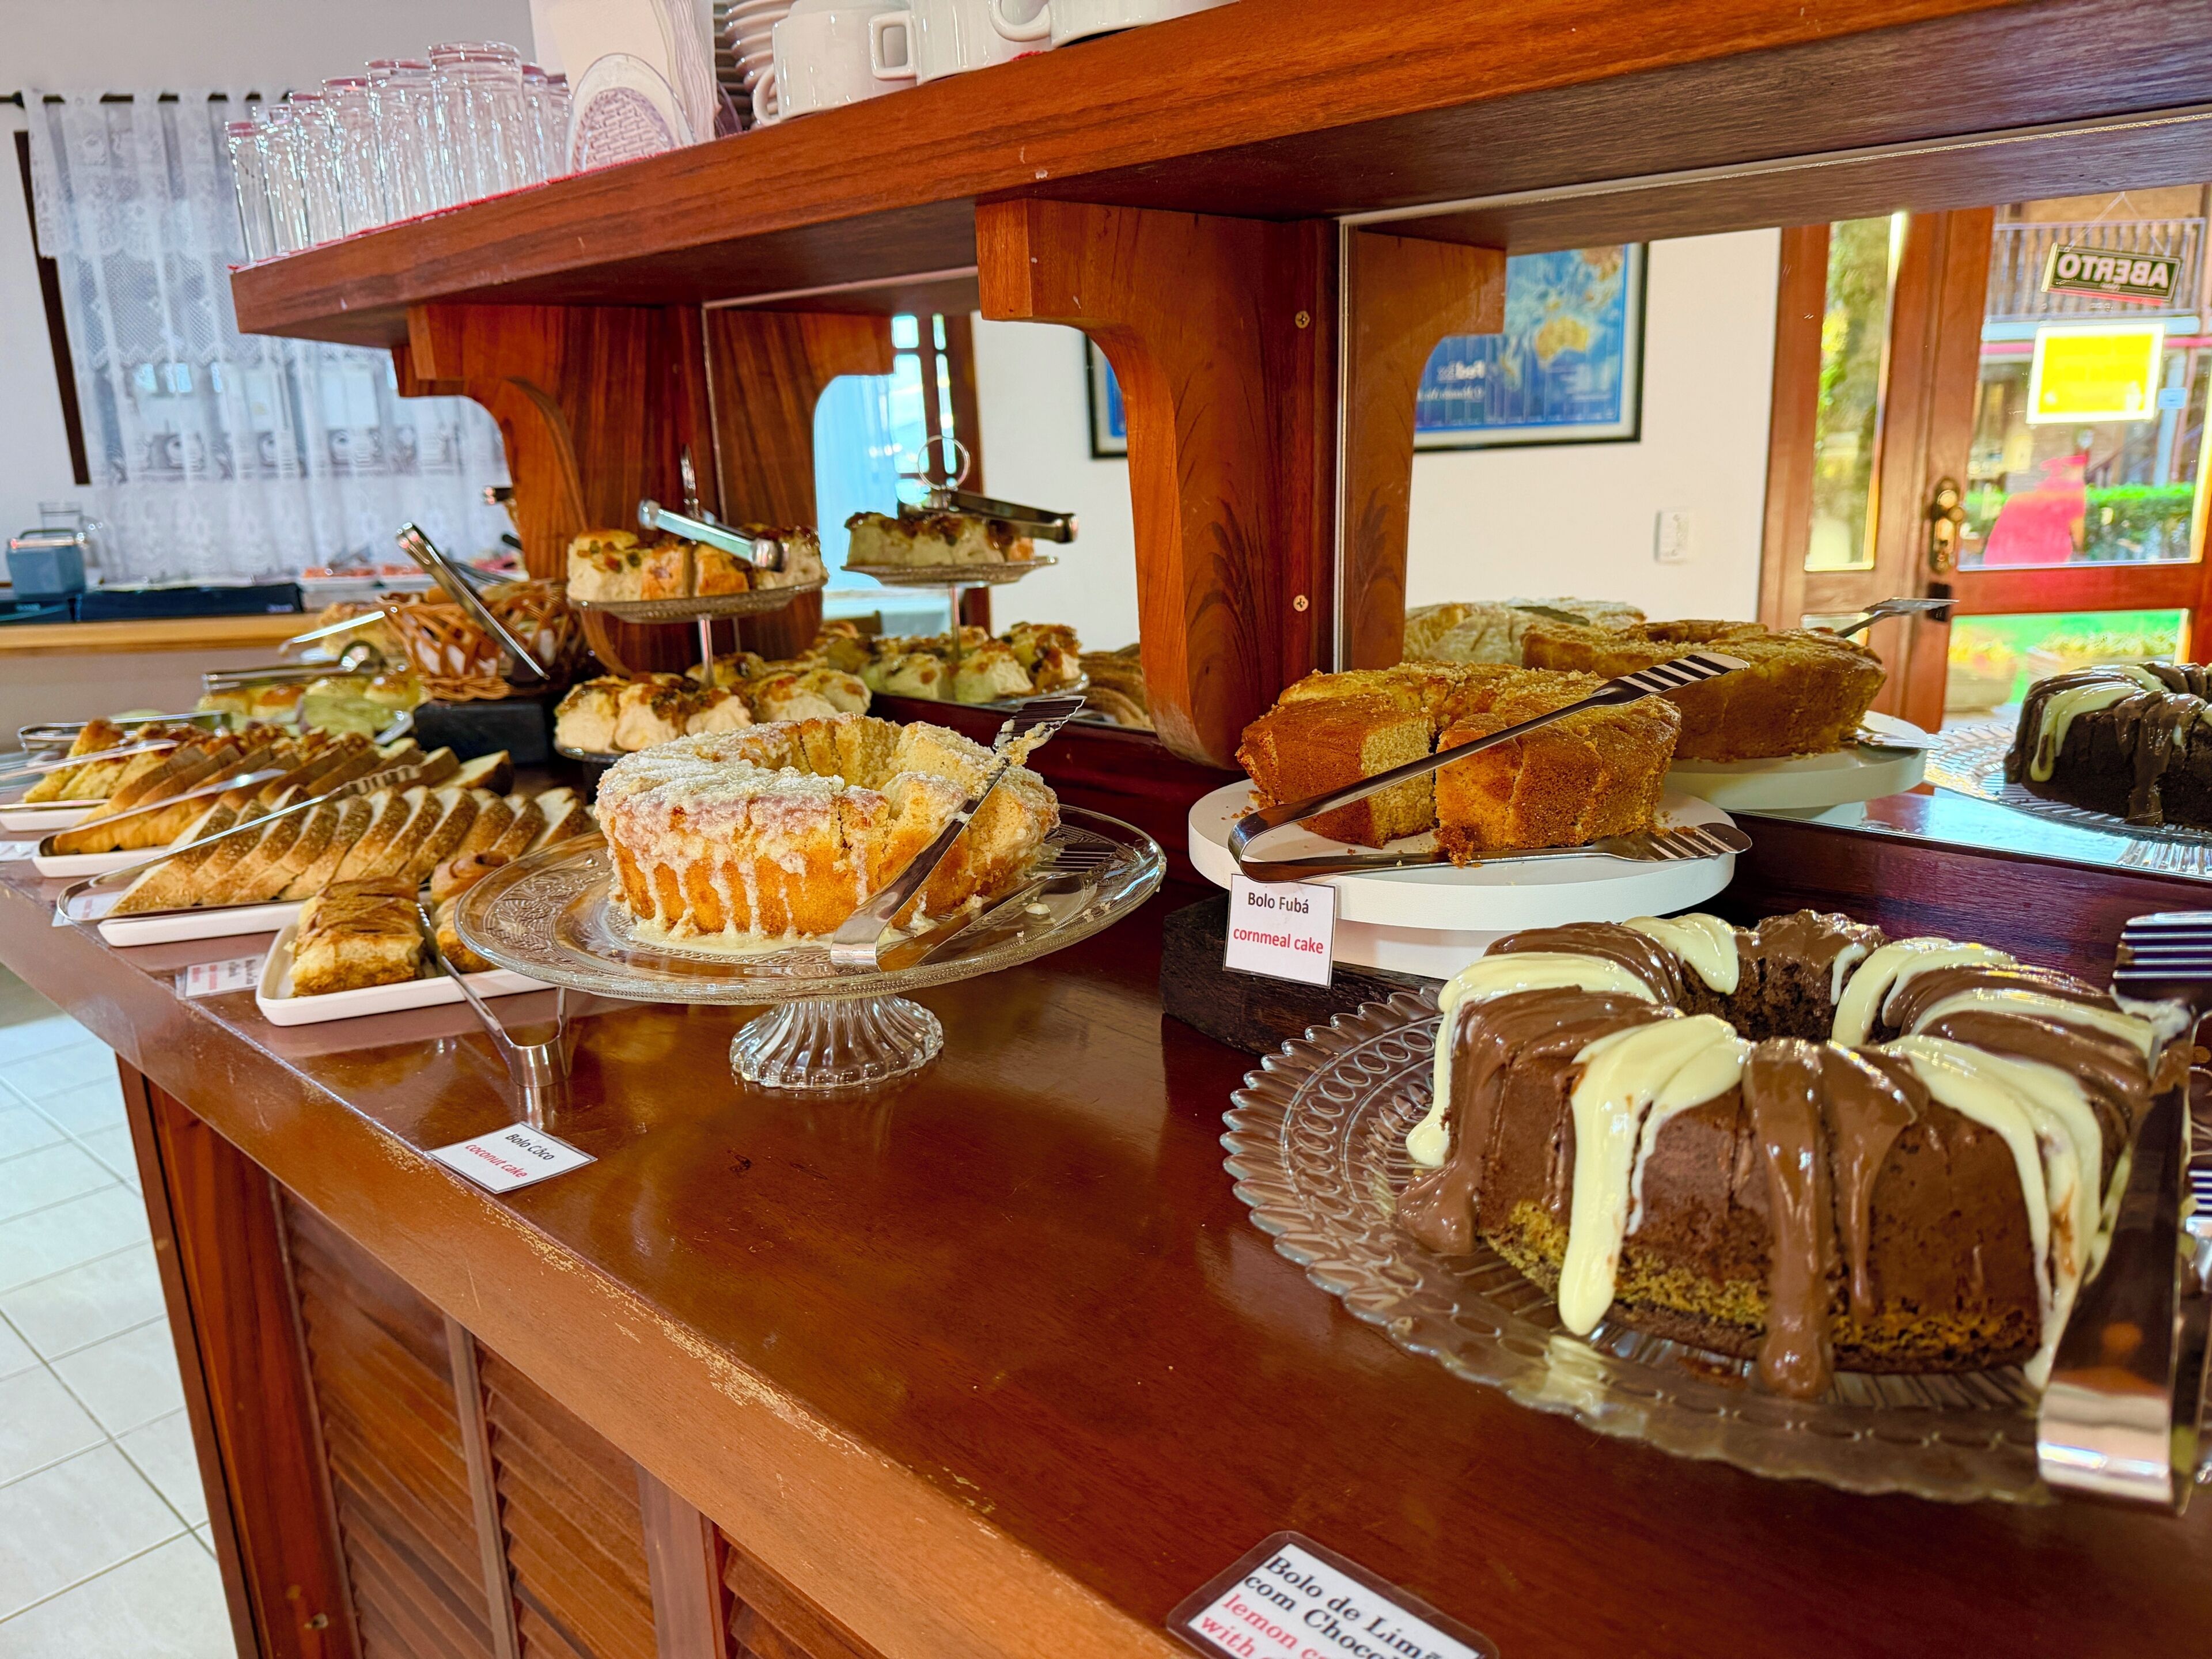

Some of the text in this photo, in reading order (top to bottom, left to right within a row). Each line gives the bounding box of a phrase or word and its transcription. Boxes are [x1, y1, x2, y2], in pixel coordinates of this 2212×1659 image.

[1248, 892, 1309, 914] Bolo Fubá
[1233, 929, 1324, 954] cornmeal cake
[465, 1143, 528, 1178] coconut cake
[505, 1134, 555, 1161] Bolo Côco
[1264, 1555, 1323, 1598] Bolo
[1327, 1596, 1361, 1621] de
[1222, 1594, 1298, 1650] lemon
[1244, 1574, 1399, 1659] com Choco
[1200, 1616, 1256, 1658] with
